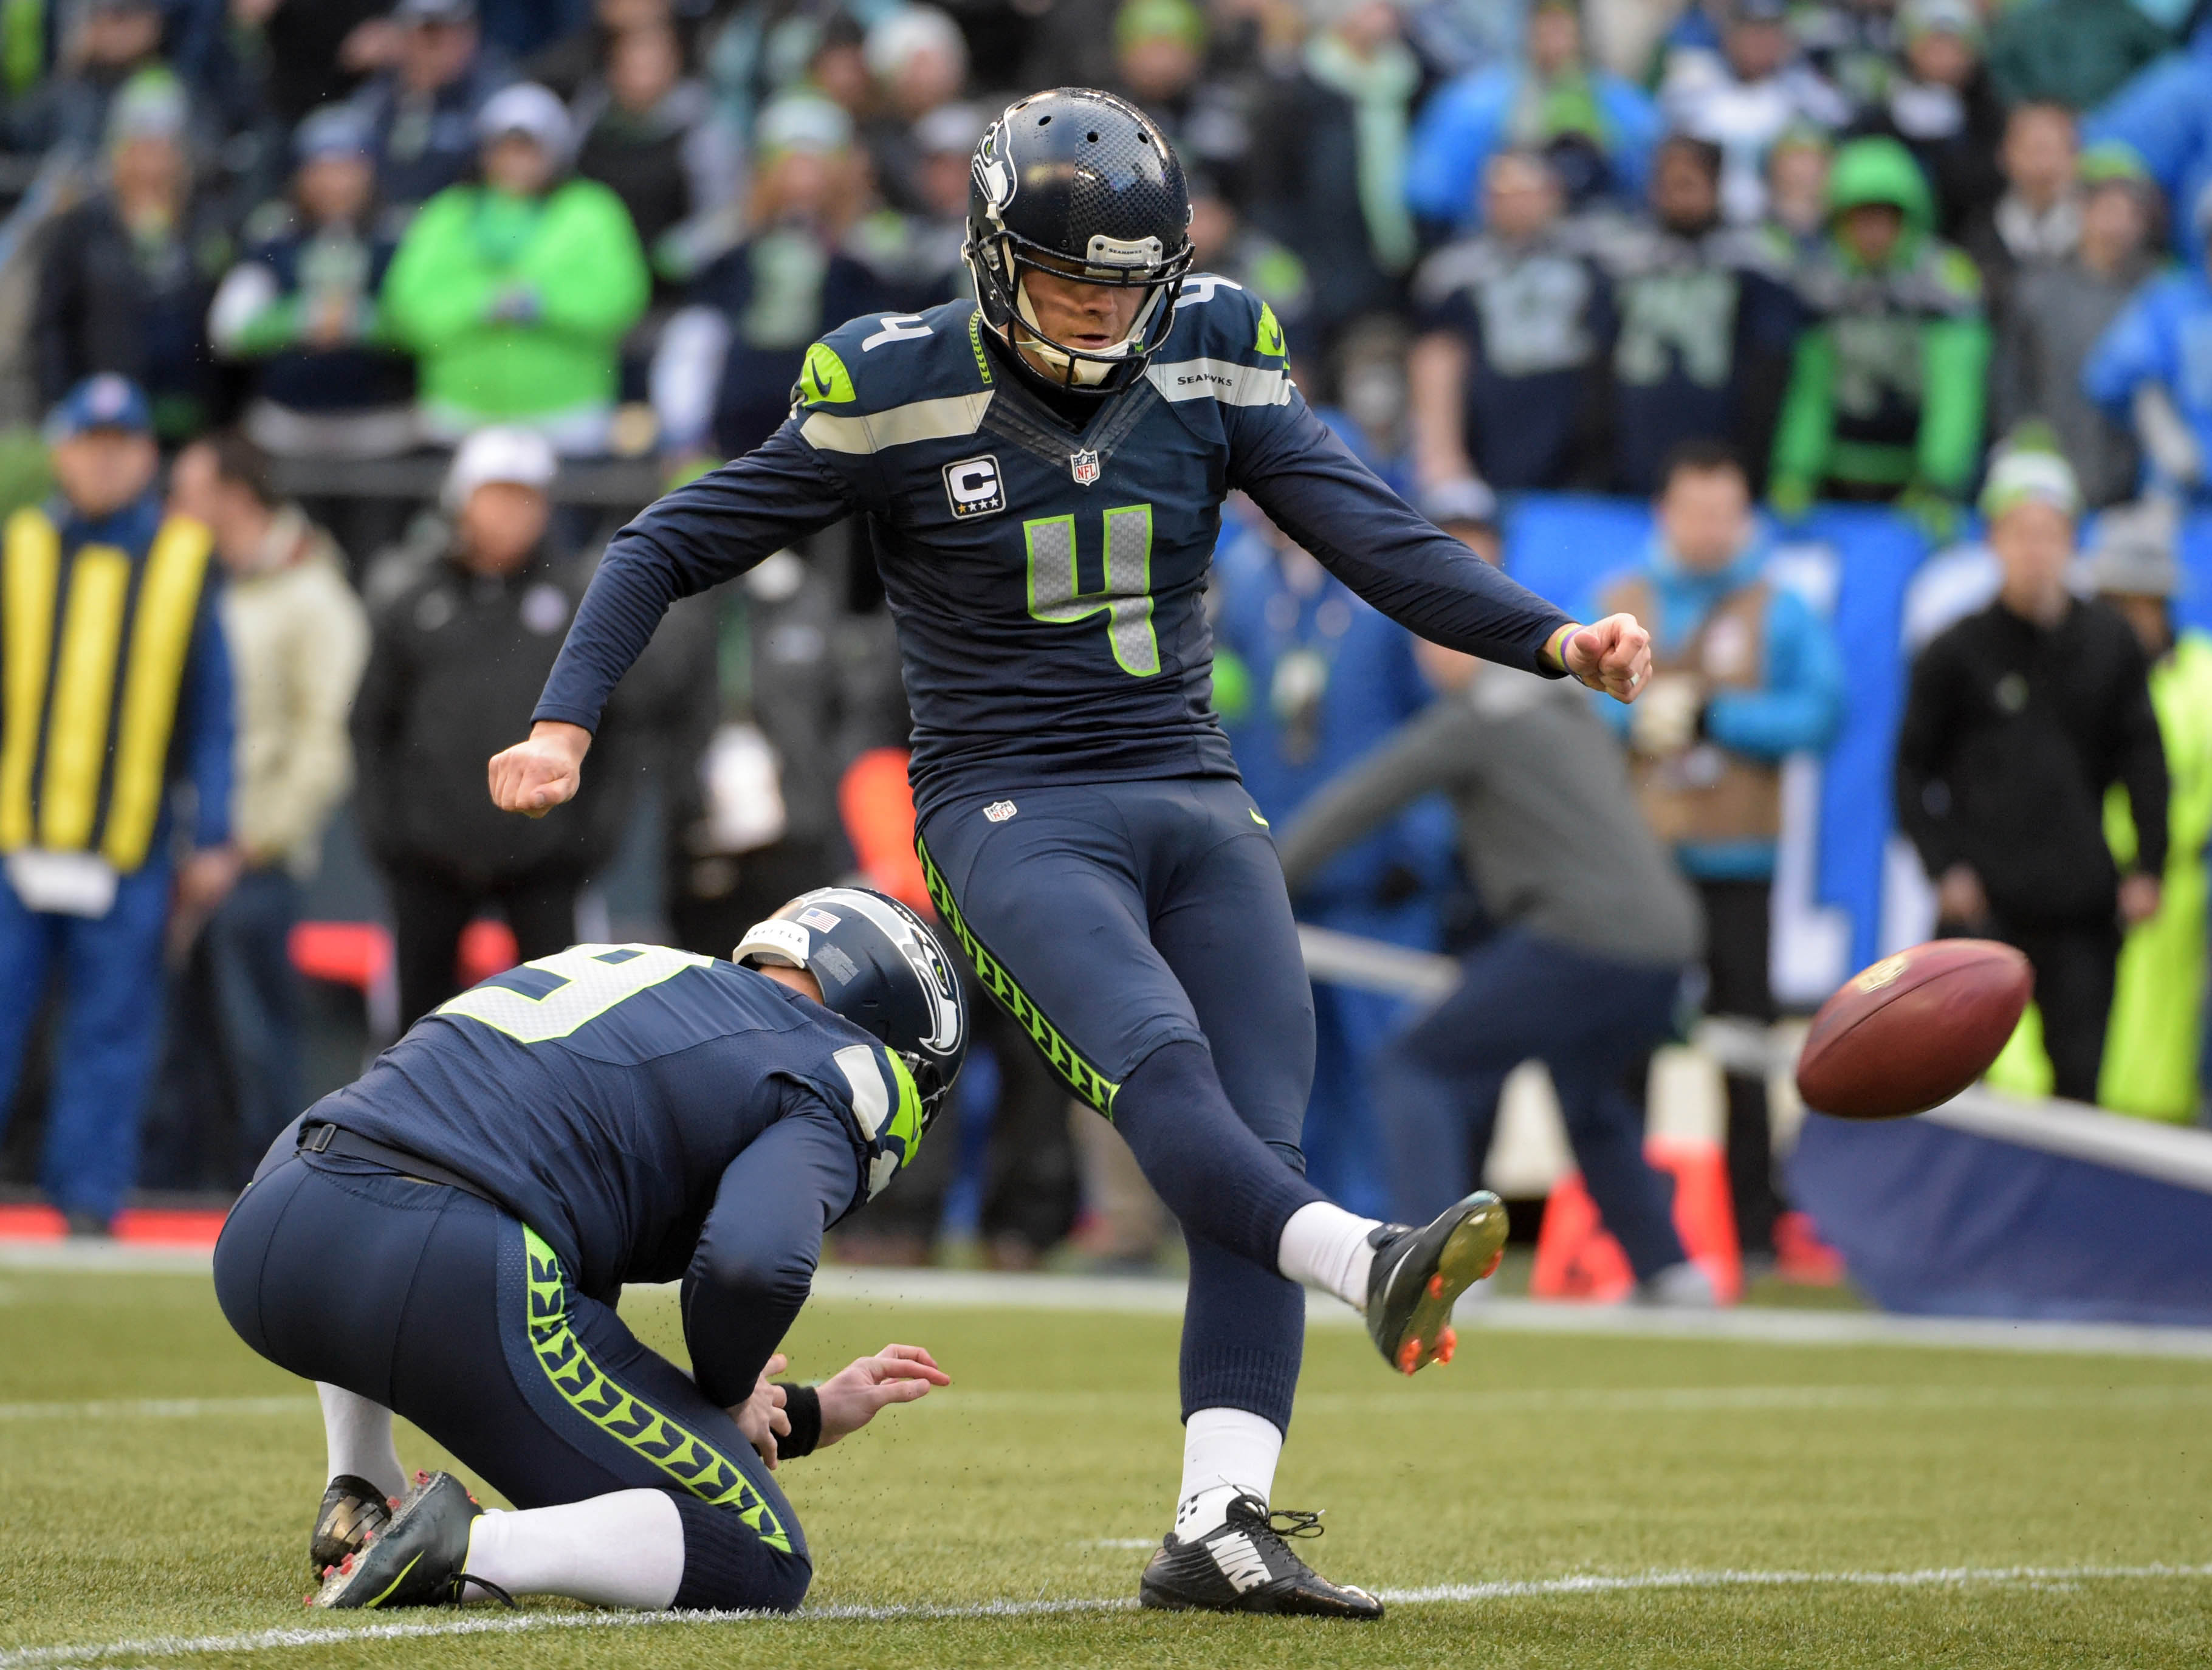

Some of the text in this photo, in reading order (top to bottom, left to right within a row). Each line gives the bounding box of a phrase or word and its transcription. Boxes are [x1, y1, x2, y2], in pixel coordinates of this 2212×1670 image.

[861, 315, 935, 352] 4
[949, 461, 998, 503] C
[1076, 464, 1095, 479] NFL
[1023, 503, 1161, 677] 4
[992, 807, 1012, 819] NFL
[435, 943, 715, 1044] 9
[1205, 1530, 1273, 1593] NIKE
